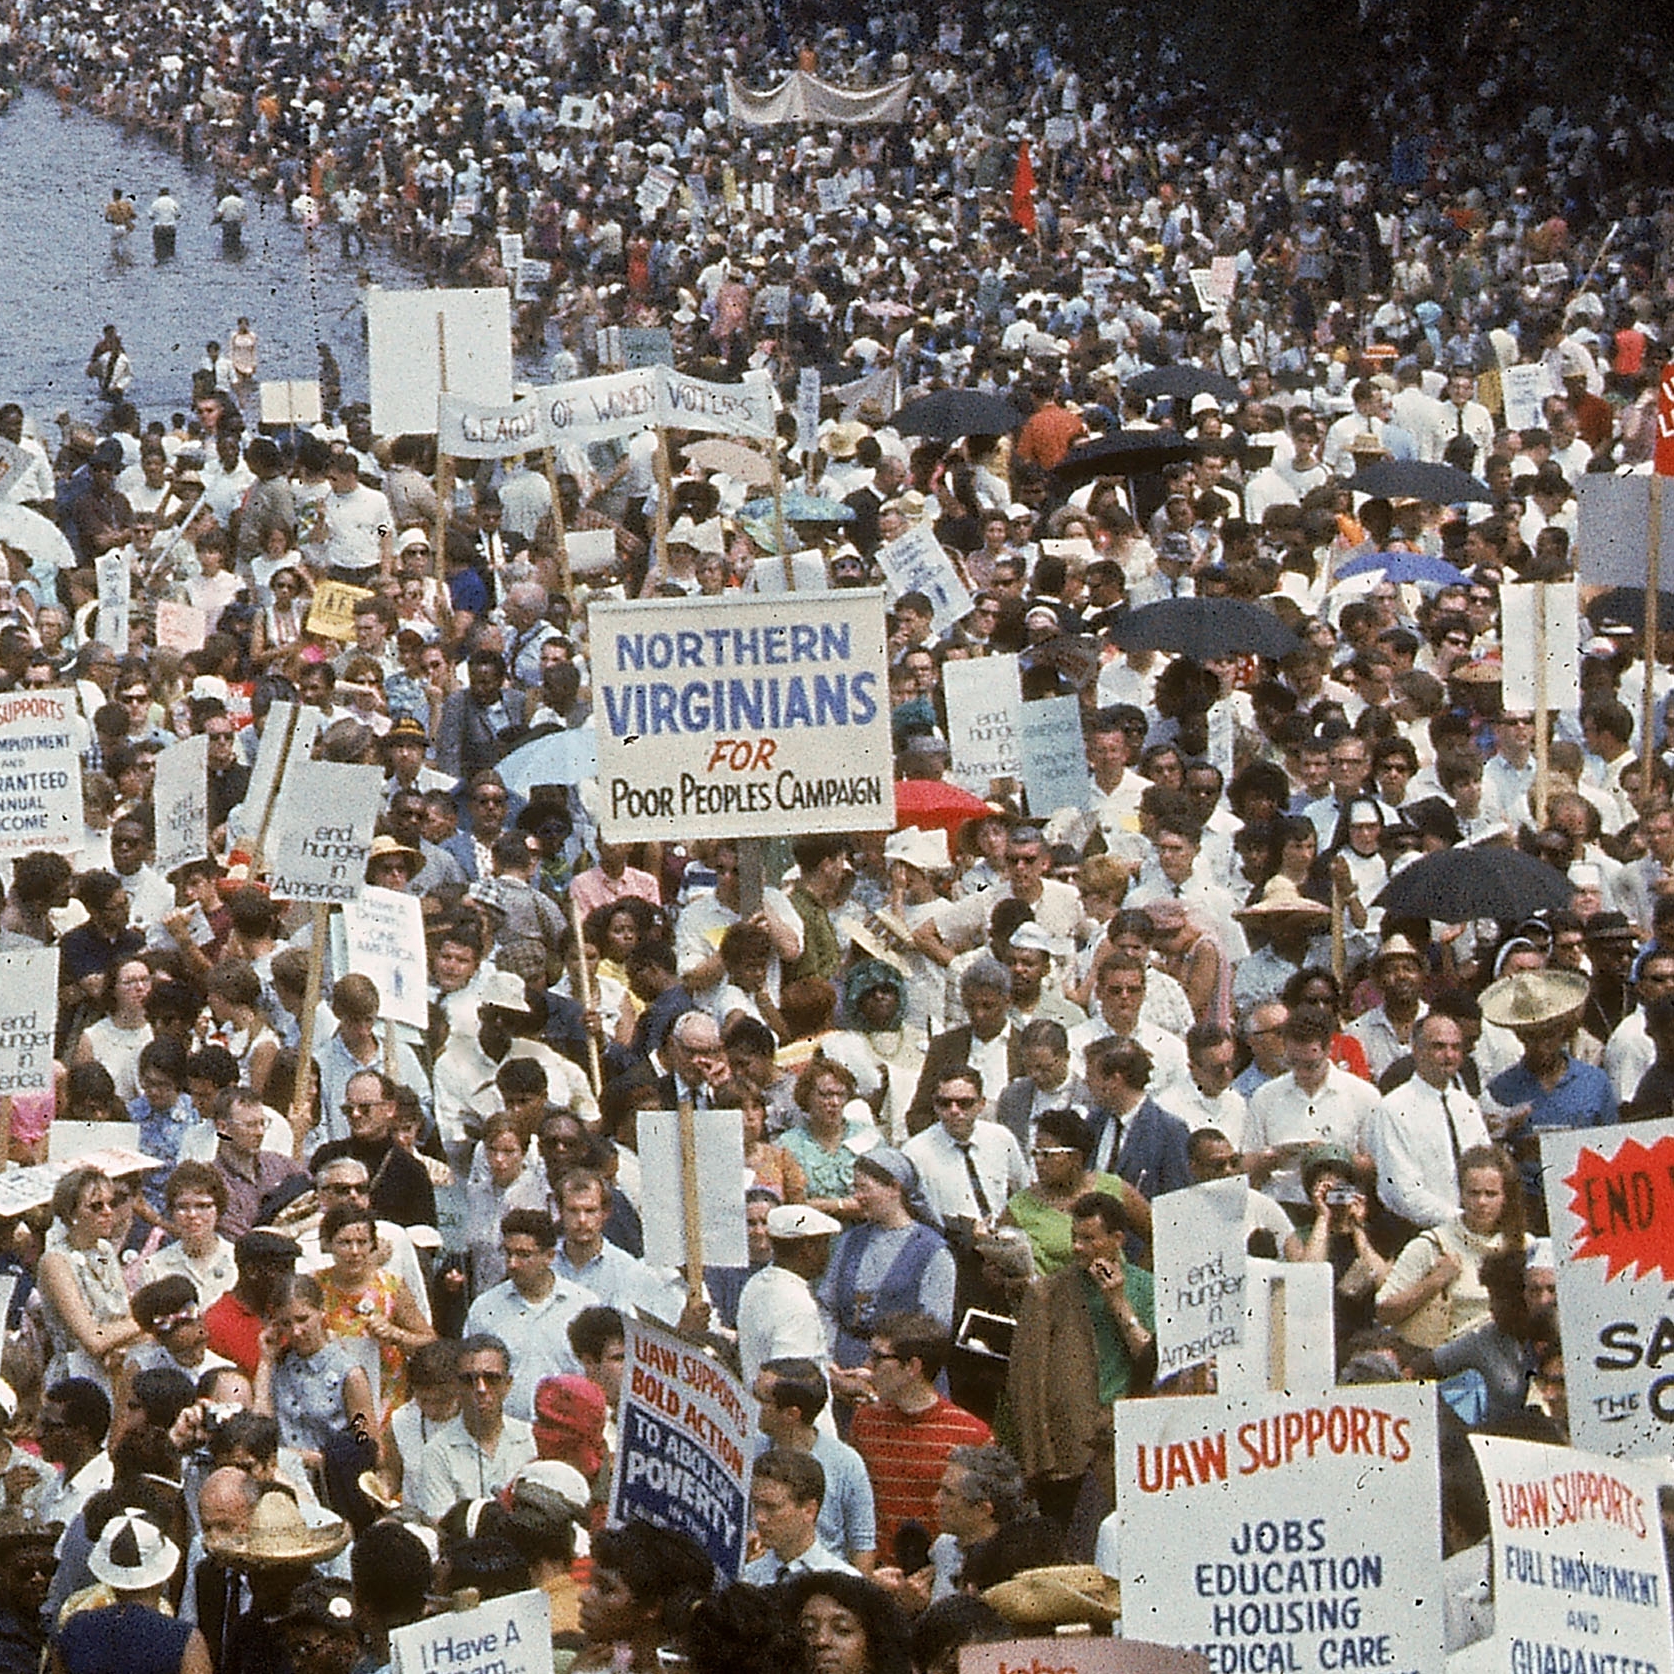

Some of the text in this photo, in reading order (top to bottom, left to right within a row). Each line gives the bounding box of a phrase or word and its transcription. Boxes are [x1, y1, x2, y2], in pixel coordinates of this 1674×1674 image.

[666, 380, 754, 422] VOTERS
[615, 622, 851, 671] NORTHERN
[602, 671, 877, 737] VIRGINIANS
[976, 708, 1008, 726] end
[707, 738, 779, 773] FOR
[611, 768, 883, 820] POOR PEOPLES CAMPAIGN
[301, 838, 369, 862] hunger
[315, 822, 354, 842] end
[331, 863, 346, 878] in
[1, 1010, 37, 1034] end
[18, 1053, 34, 1069] in
[1585, 1171, 1656, 1238] END
[1186, 1253, 1223, 1287] end
[1176, 1273, 1247, 1314] hunger
[635, 1338, 747, 1438] UAW SUPPORTS
[1594, 1392, 1639, 1417] THE
[631, 1367, 744, 1477] BOLD ACTION
[635, 1412, 733, 1509] TO ABOLISH
[1137, 1405, 1412, 1493] UAW SUPPORTS
[628, 1450, 736, 1549] POVERTY
[1498, 1471, 1647, 1540] UAW SUPPORTS
[1232, 1518, 1326, 1557] JOBS
[1196, 1555, 1383, 1599] EDUCATION
[1505, 1545, 1660, 1608] FULL EMPLOYMENT
[1214, 1598, 1360, 1638] HOUSING
[1567, 1609, 1601, 1634] AND
[433, 1630, 499, 1666] Have
[504, 1619, 523, 1647] A
[1318, 1635, 1391, 1671] CARE
